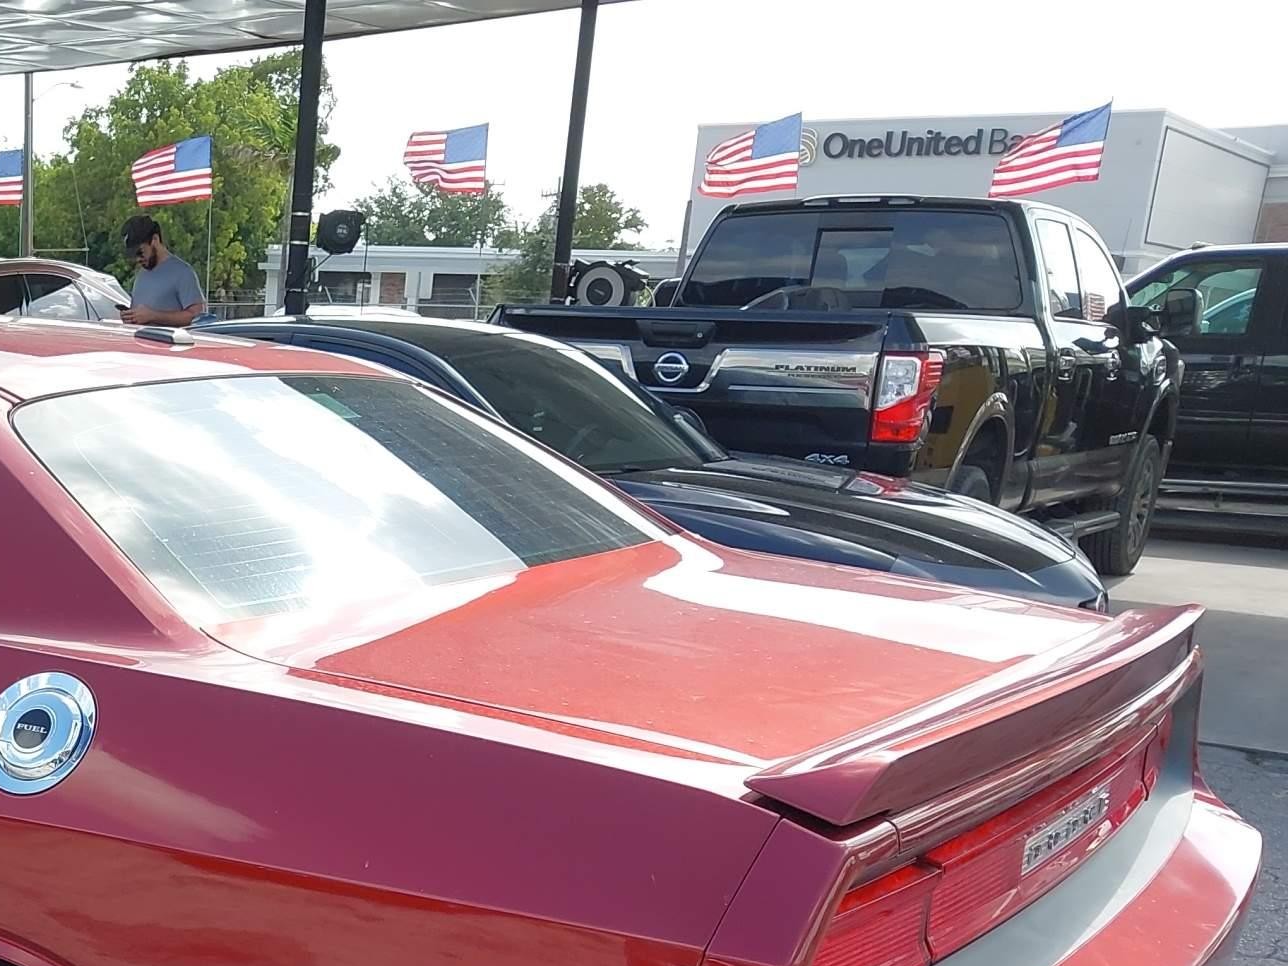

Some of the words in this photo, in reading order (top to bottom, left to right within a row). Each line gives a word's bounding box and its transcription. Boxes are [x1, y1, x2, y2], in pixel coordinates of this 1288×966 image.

[823, 128, 984, 159] OneUnited
[774, 364, 857, 373] PLATINUM
[16, 722, 48, 734] FUEL
